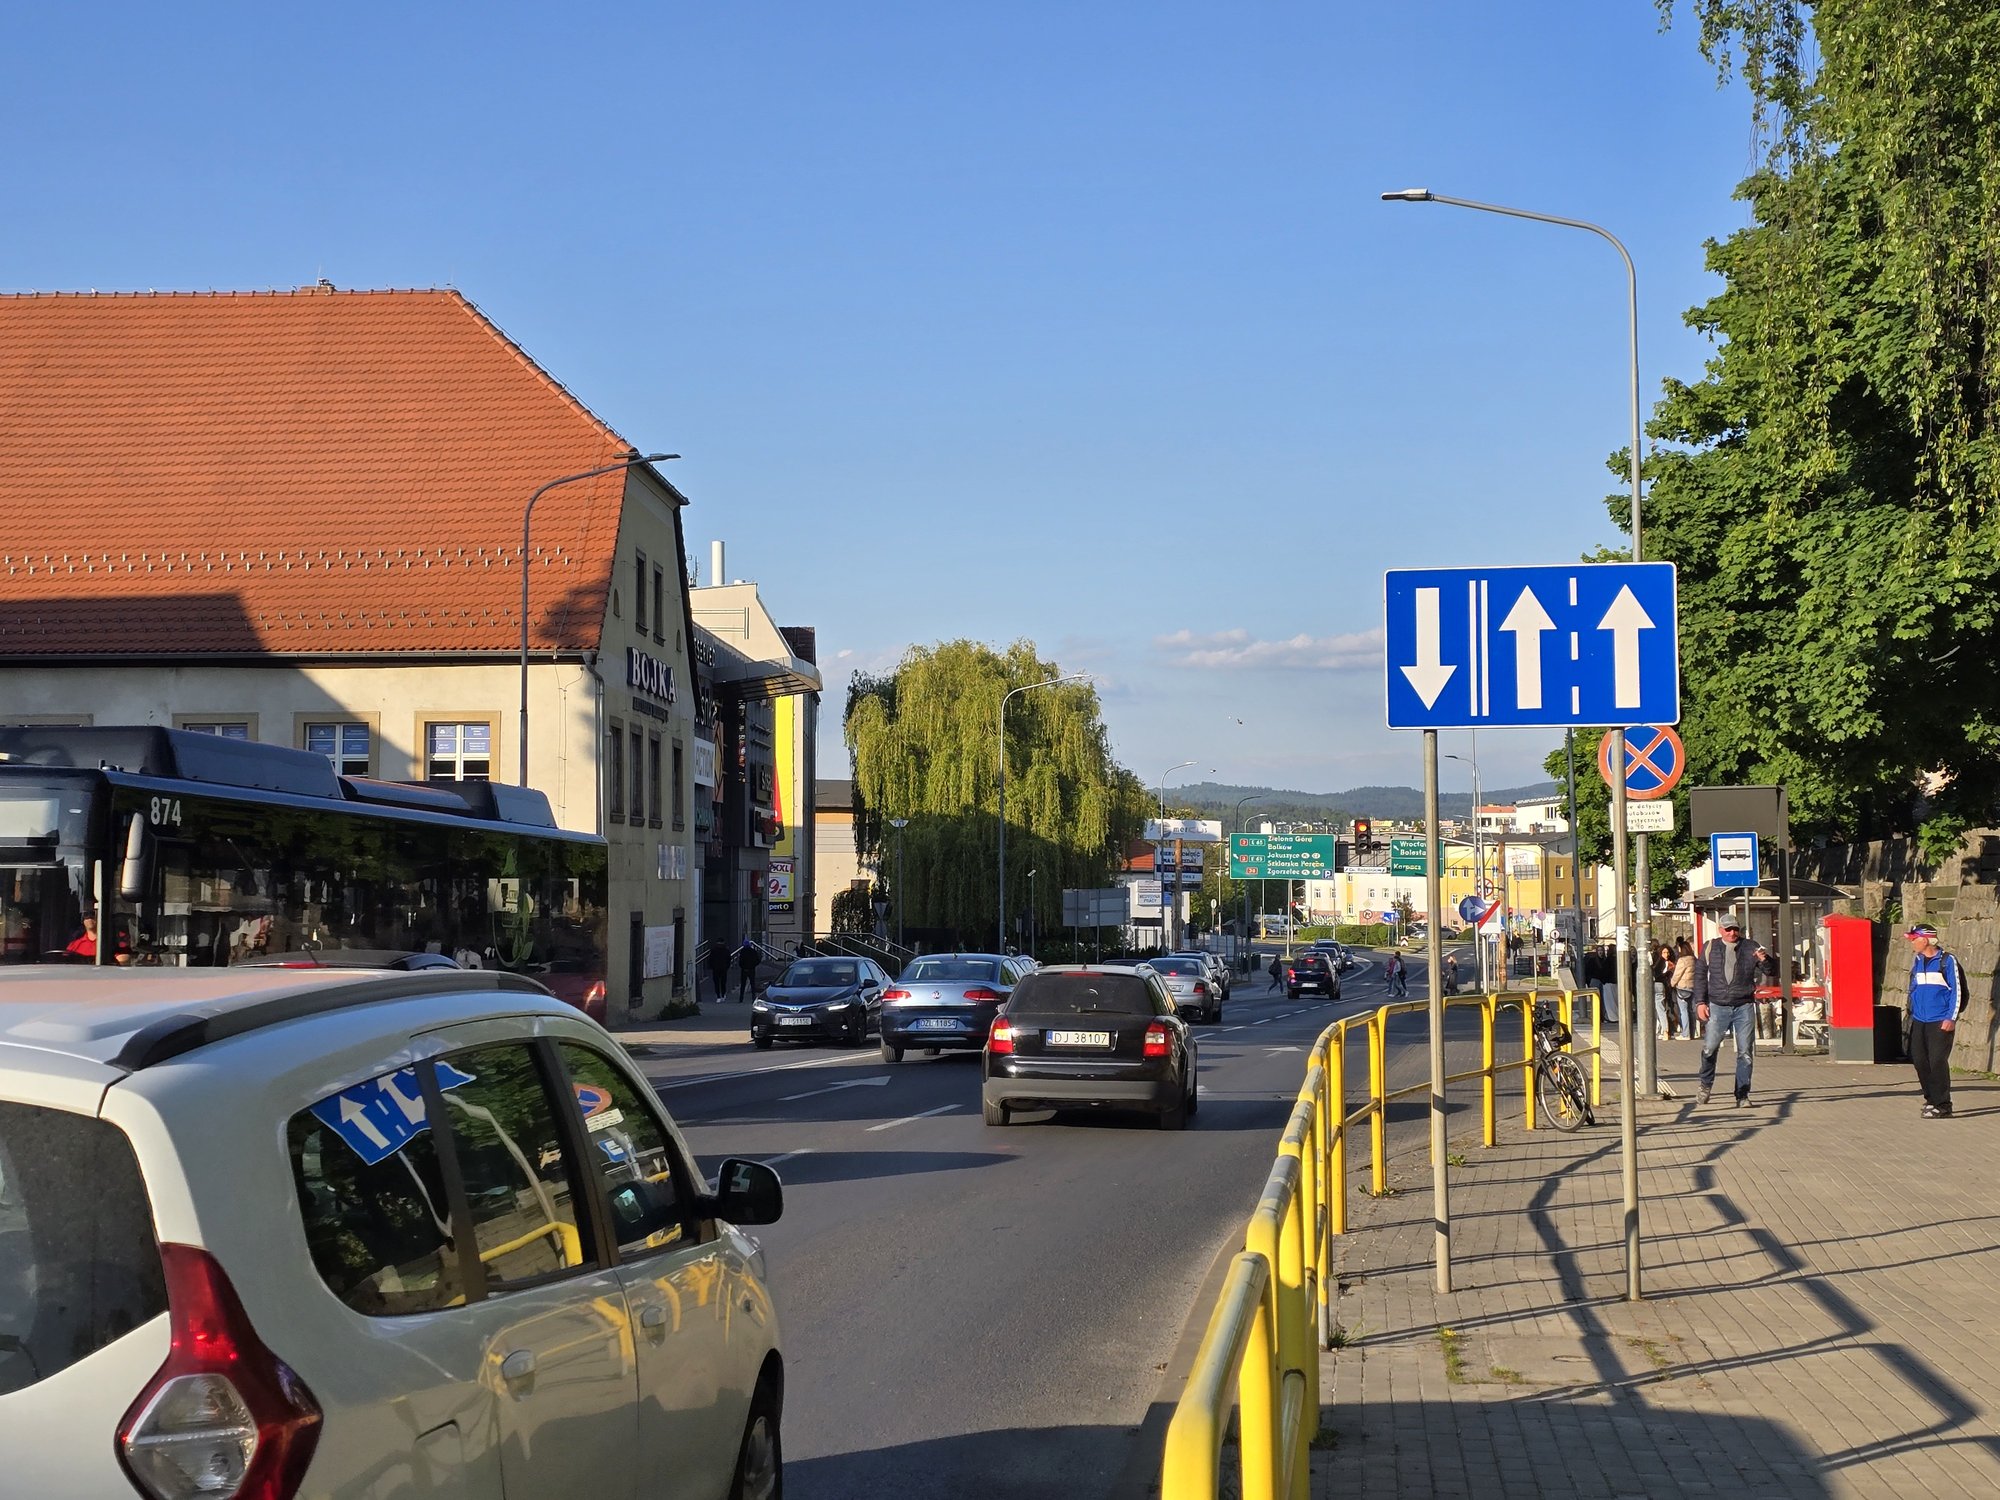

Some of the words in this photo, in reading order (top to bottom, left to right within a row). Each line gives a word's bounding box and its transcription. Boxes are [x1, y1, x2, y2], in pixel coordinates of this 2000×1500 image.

[632, 647, 677, 703] BOJKA
[151, 796, 182, 827] 874
[1267, 852, 1300, 860] Jakuszyce
[1301, 860, 1325, 868] Poręba
[1393, 863, 1422, 871] Karpacz
[1267, 868, 1300, 876] Zgorzelec
[1054, 1032, 1069, 1043] DJ
[1074, 1032, 1107, 1044] 38107
